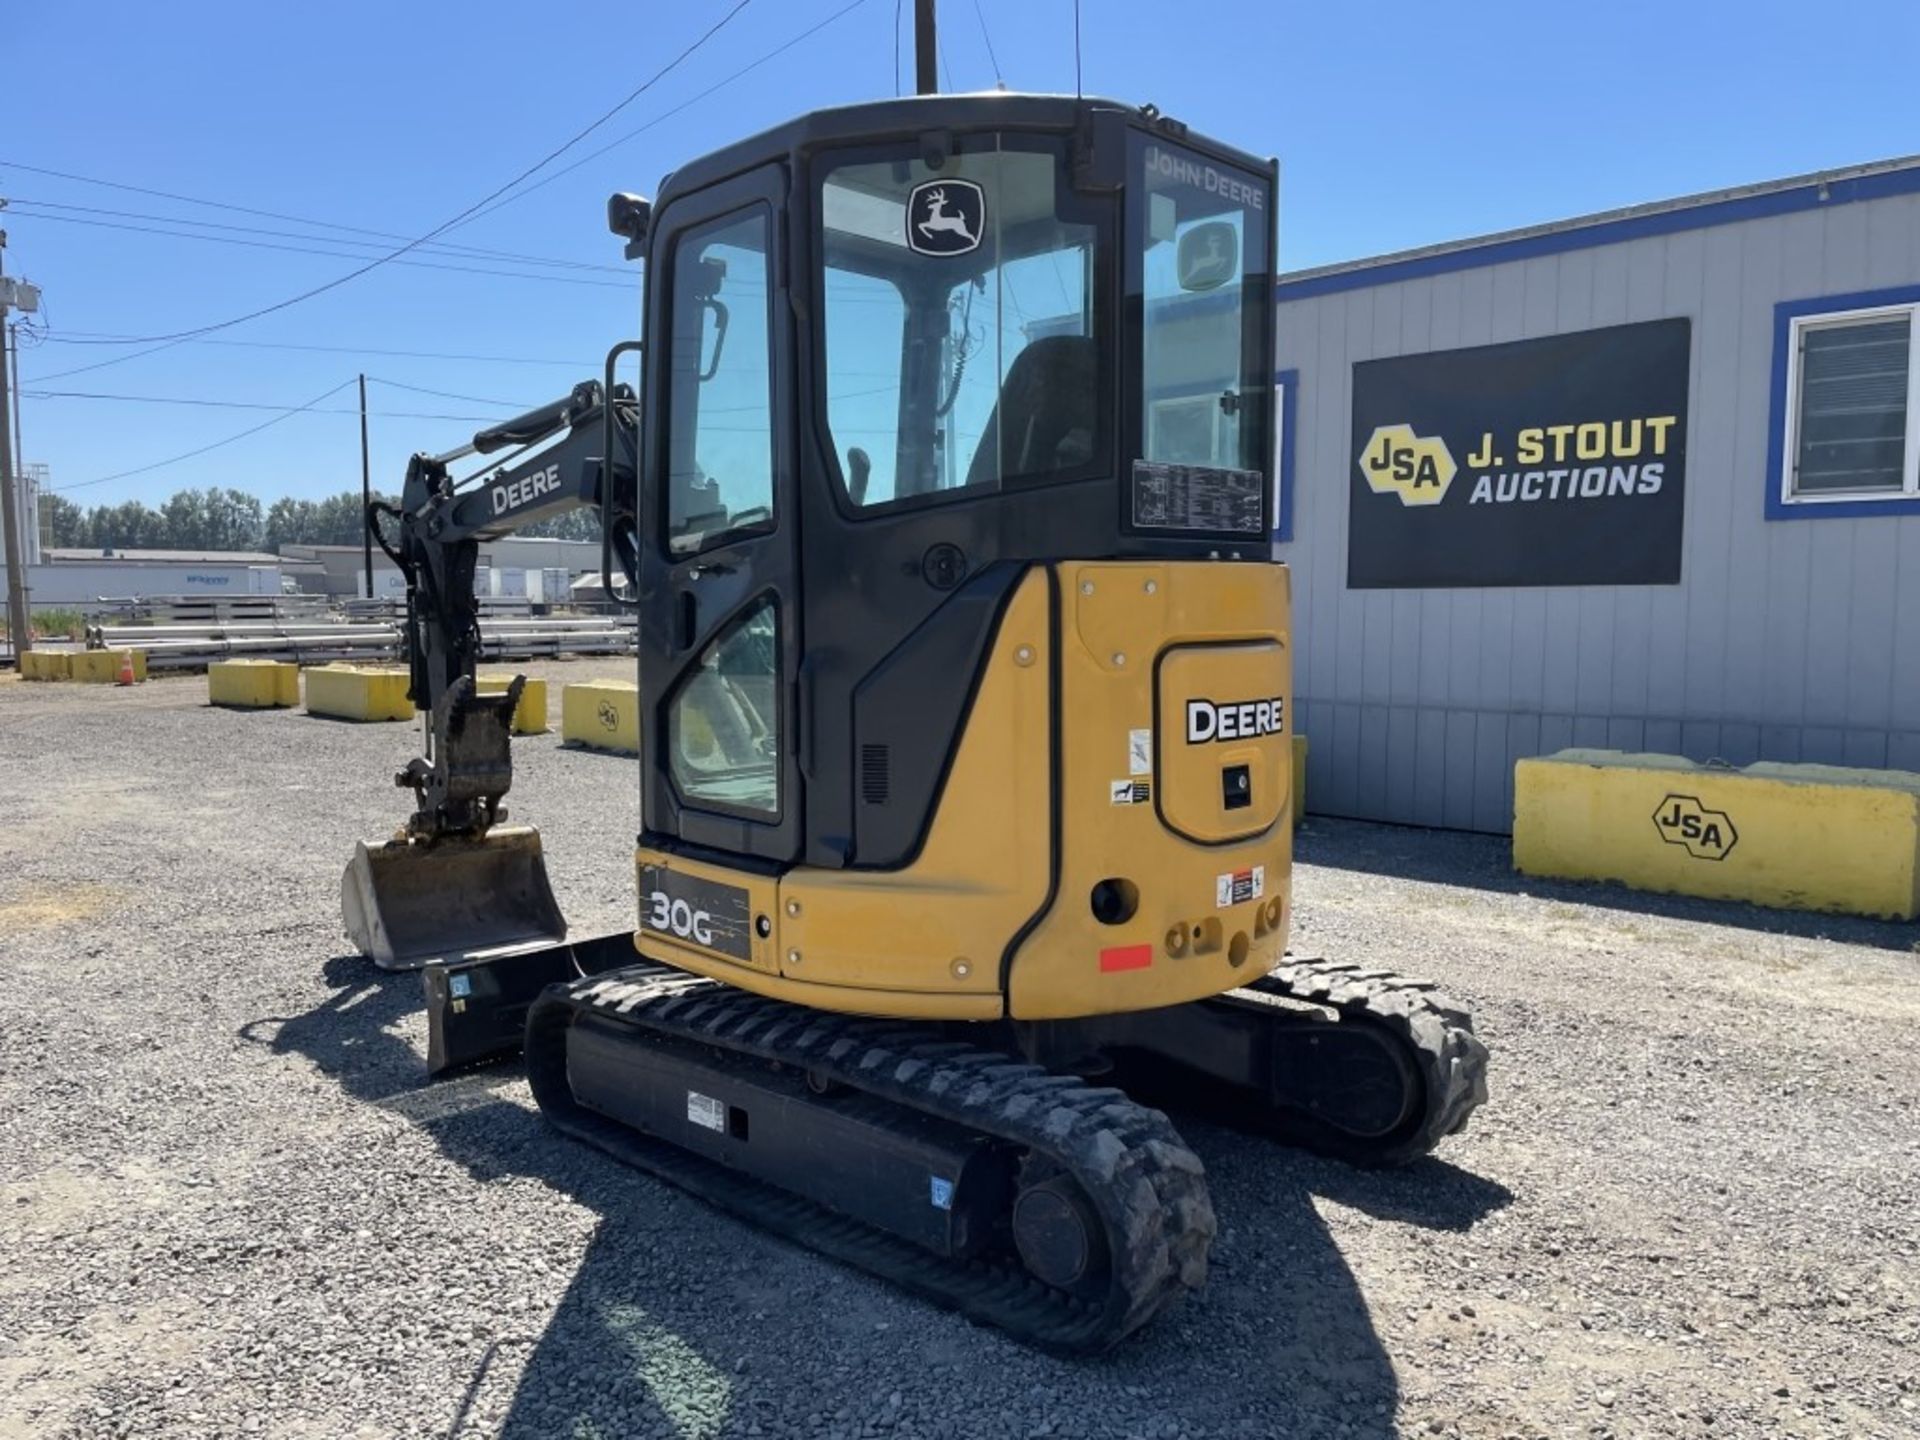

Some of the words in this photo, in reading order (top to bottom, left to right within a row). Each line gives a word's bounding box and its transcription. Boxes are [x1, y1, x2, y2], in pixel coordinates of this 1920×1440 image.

[1145, 147, 1200, 187] JOHN
[1204, 166, 1263, 210] DEERE
[1370, 438, 1440, 488] JSA
[1468, 432, 1503, 469] J.
[1517, 416, 1677, 464] STOUT
[492, 464, 562, 516] DEERE
[1469, 462, 1664, 504] AUCTIONS
[1188, 699, 1282, 743] DEERE
[1662, 804, 1722, 849] JSA
[650, 891, 712, 946] 30G
